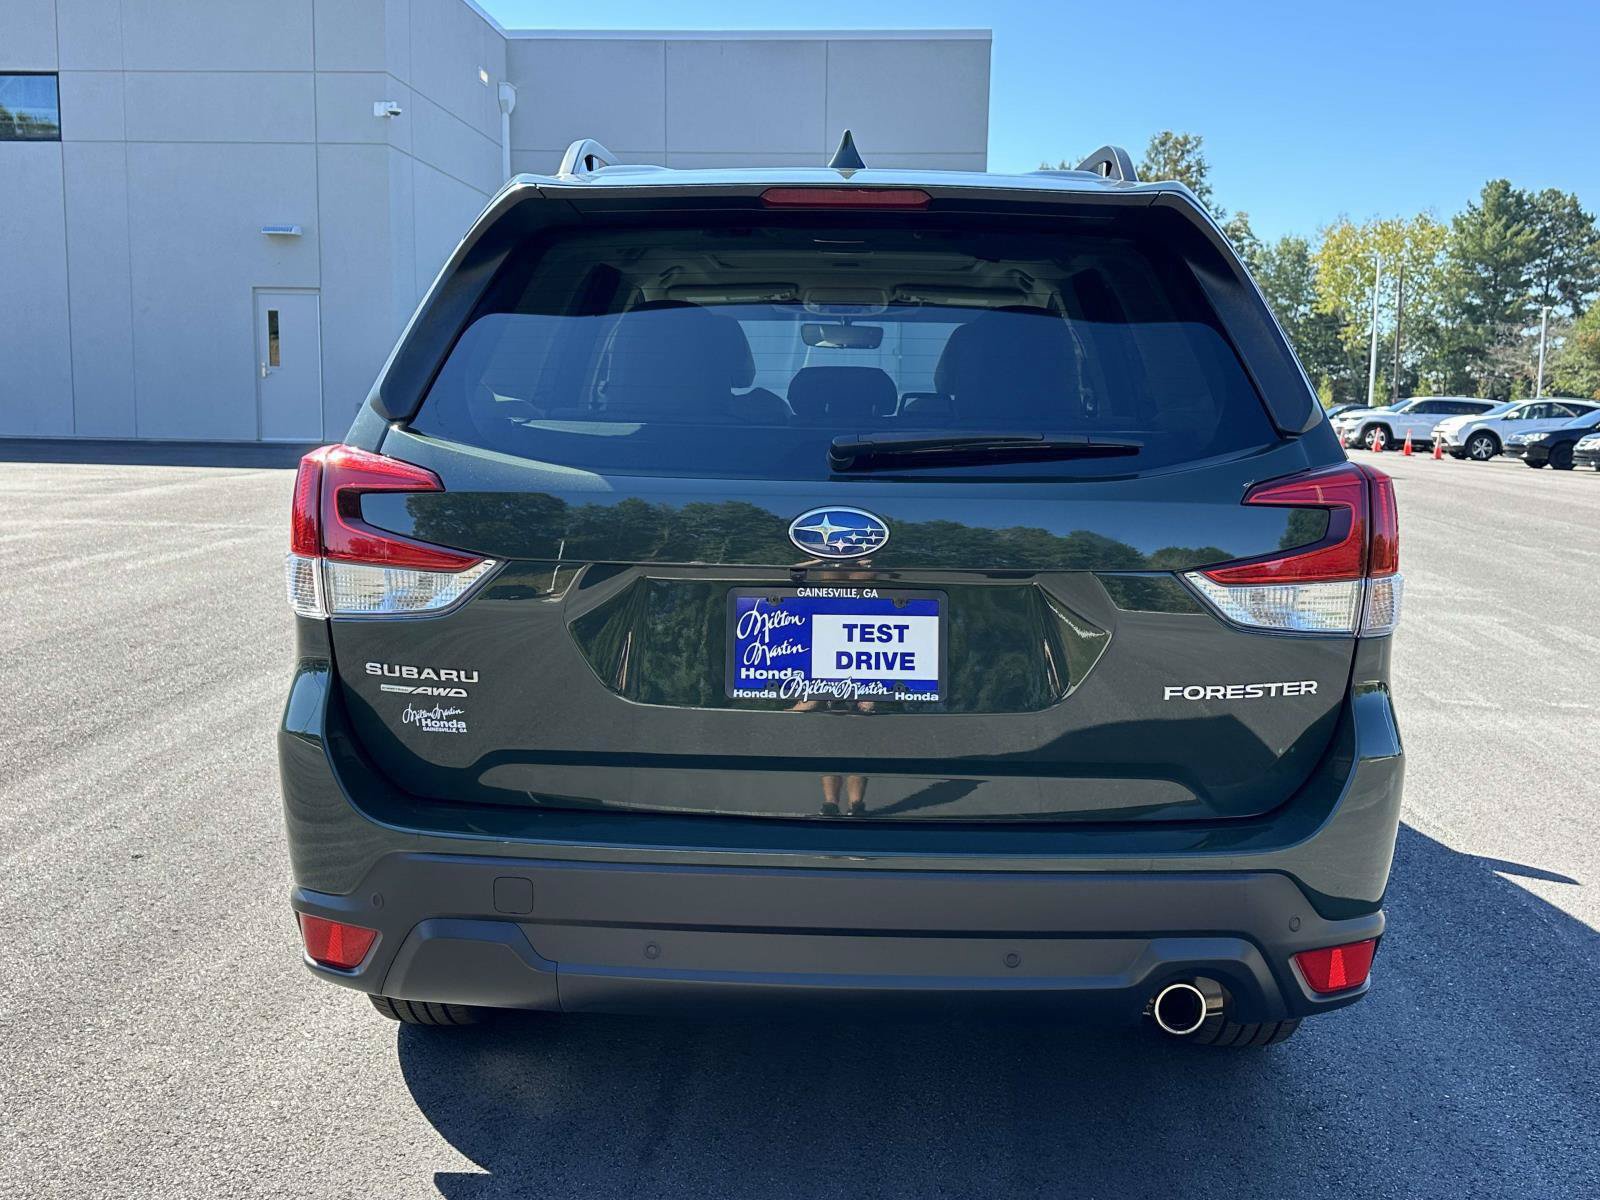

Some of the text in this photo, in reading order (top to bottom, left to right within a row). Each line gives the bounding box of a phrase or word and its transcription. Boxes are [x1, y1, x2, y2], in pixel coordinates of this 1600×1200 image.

[797, 587, 878, 599] GAINESVILLE, GA
[736, 599, 806, 643] Milton
[842, 624, 909, 643] TEST
[743, 633, 810, 666] Martin
[835, 652, 916, 671] DRIVE
[365, 662, 479, 683] SUBARU
[740, 668, 804, 680] Honda
[411, 686, 468, 697] AWD
[733, 673, 939, 702] Honda Milton Martin Honda
[1163, 680, 1318, 701] FORESTER
[421, 718, 466, 728] Honda
